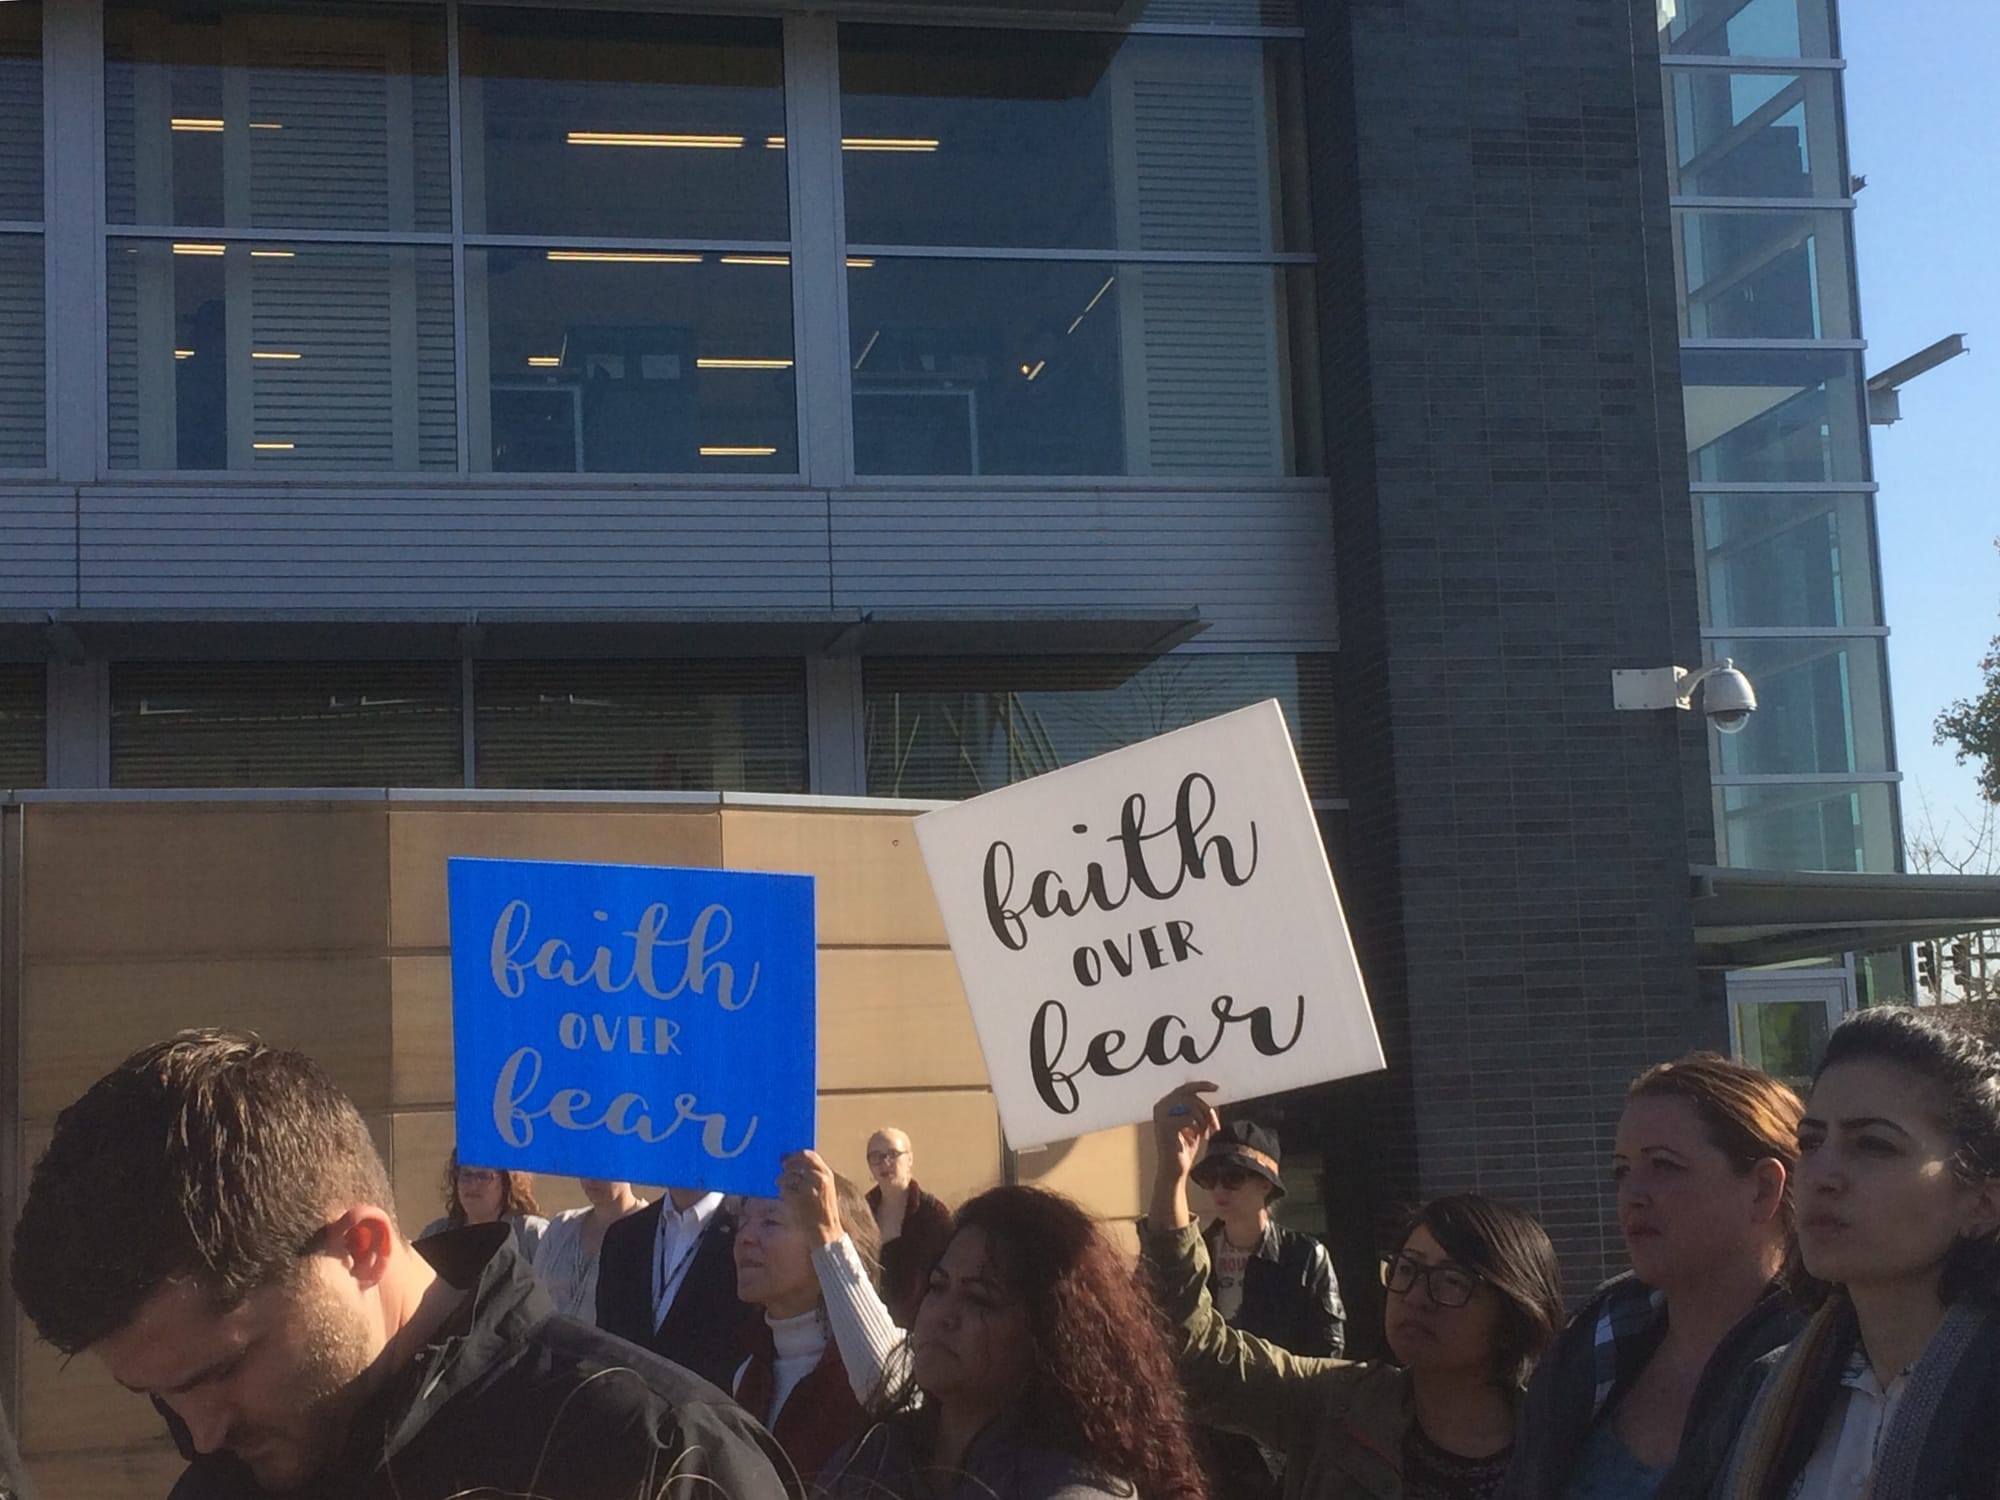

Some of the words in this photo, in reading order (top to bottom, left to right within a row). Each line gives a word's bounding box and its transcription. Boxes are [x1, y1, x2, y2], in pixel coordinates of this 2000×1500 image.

[982, 772, 1258, 950] faith
[491, 900, 760, 1011] faith
[1073, 920, 1203, 987] OVER
[559, 1013, 682, 1056] OVER
[1029, 995, 1305, 1114] fear
[493, 1047, 758, 1159] fear
